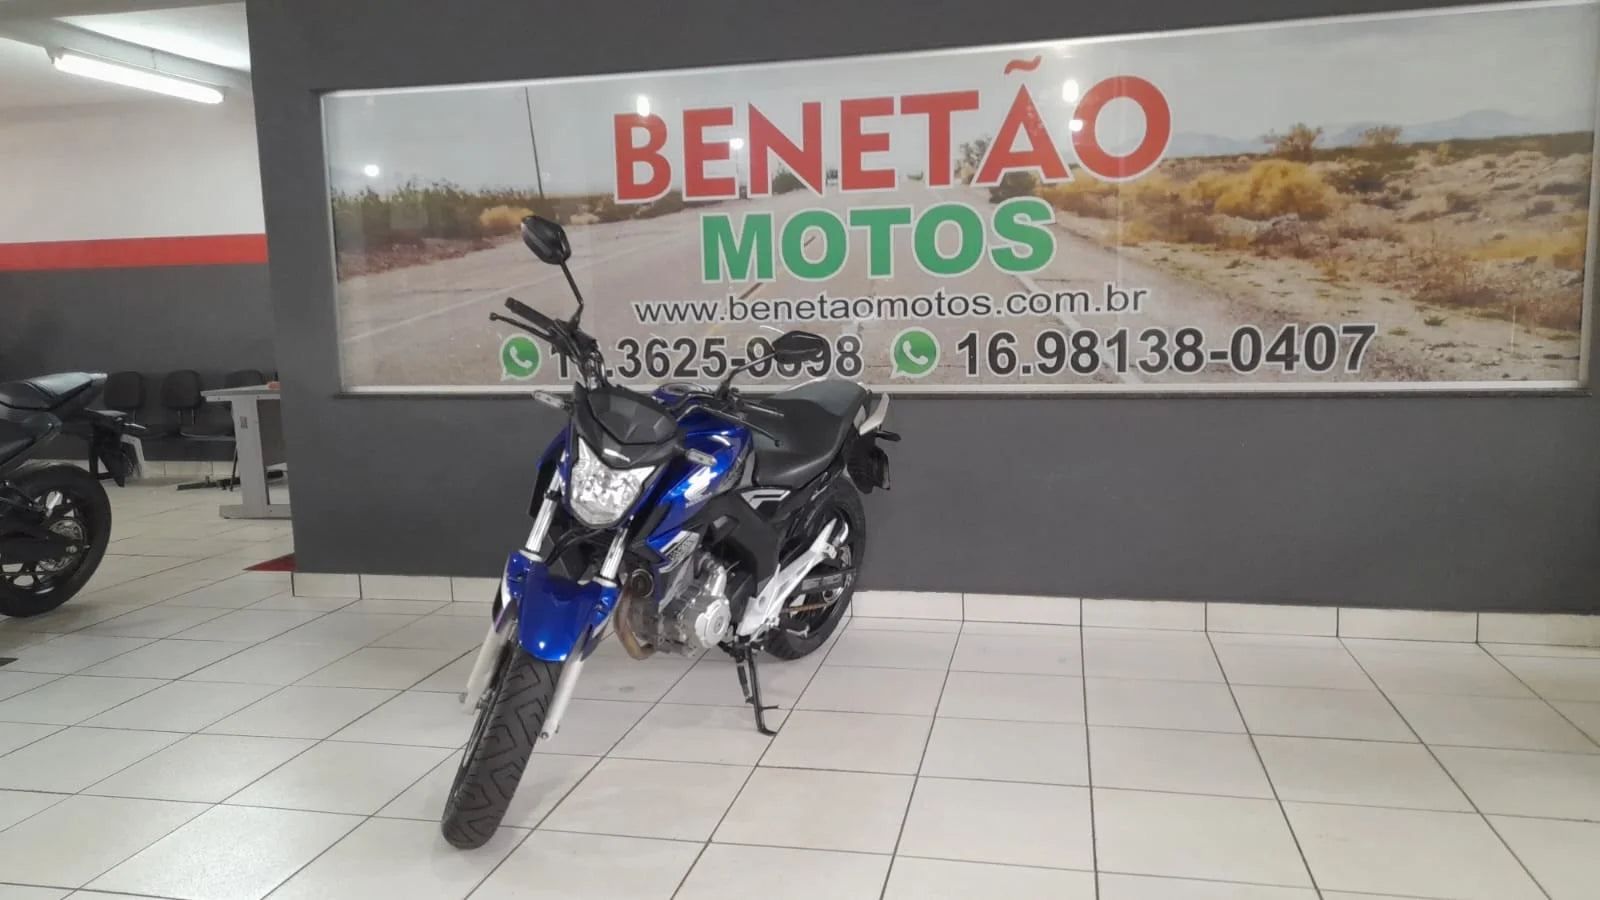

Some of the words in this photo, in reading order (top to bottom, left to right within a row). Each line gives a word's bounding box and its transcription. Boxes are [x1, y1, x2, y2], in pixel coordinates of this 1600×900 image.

[613, 55, 1171, 201] BENETÃO
[702, 198, 1055, 281] MOTOS
[634, 285, 1148, 323] www.benetaomotos.com.br
[553, 335, 863, 379] 1.3625-998
[957, 324, 1377, 376] 16.98138-0407
